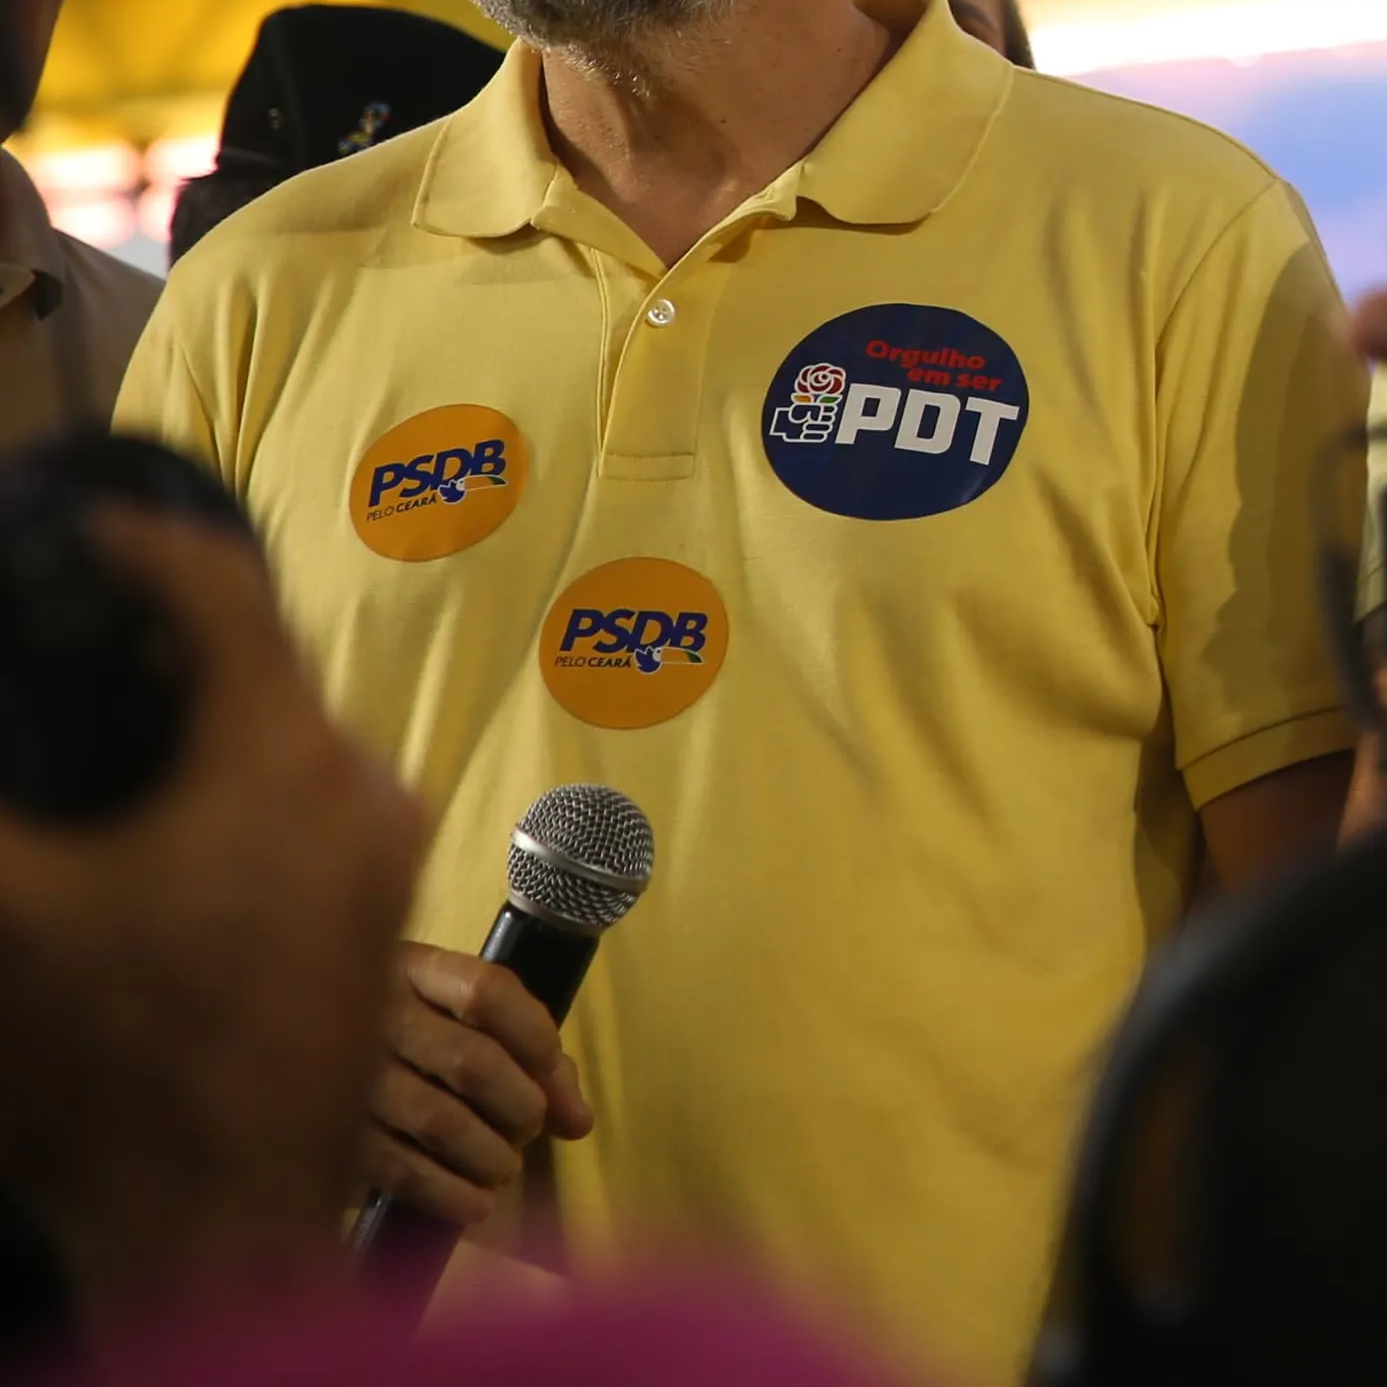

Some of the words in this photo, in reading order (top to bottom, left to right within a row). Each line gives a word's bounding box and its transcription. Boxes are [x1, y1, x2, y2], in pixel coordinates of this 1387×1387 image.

[866, 340, 985, 369] Orgulho
[907, 368, 950, 385] em
[957, 374, 1003, 392] ser
[835, 383, 1020, 465] PDT
[368, 439, 506, 508] PSDB
[366, 506, 395, 522] PELO
[397, 492, 437, 513] CEARÁ
[559, 608, 708, 653] PSDB
[554, 656, 586, 668] PELO
[587, 656, 631, 669] CEARÁ
